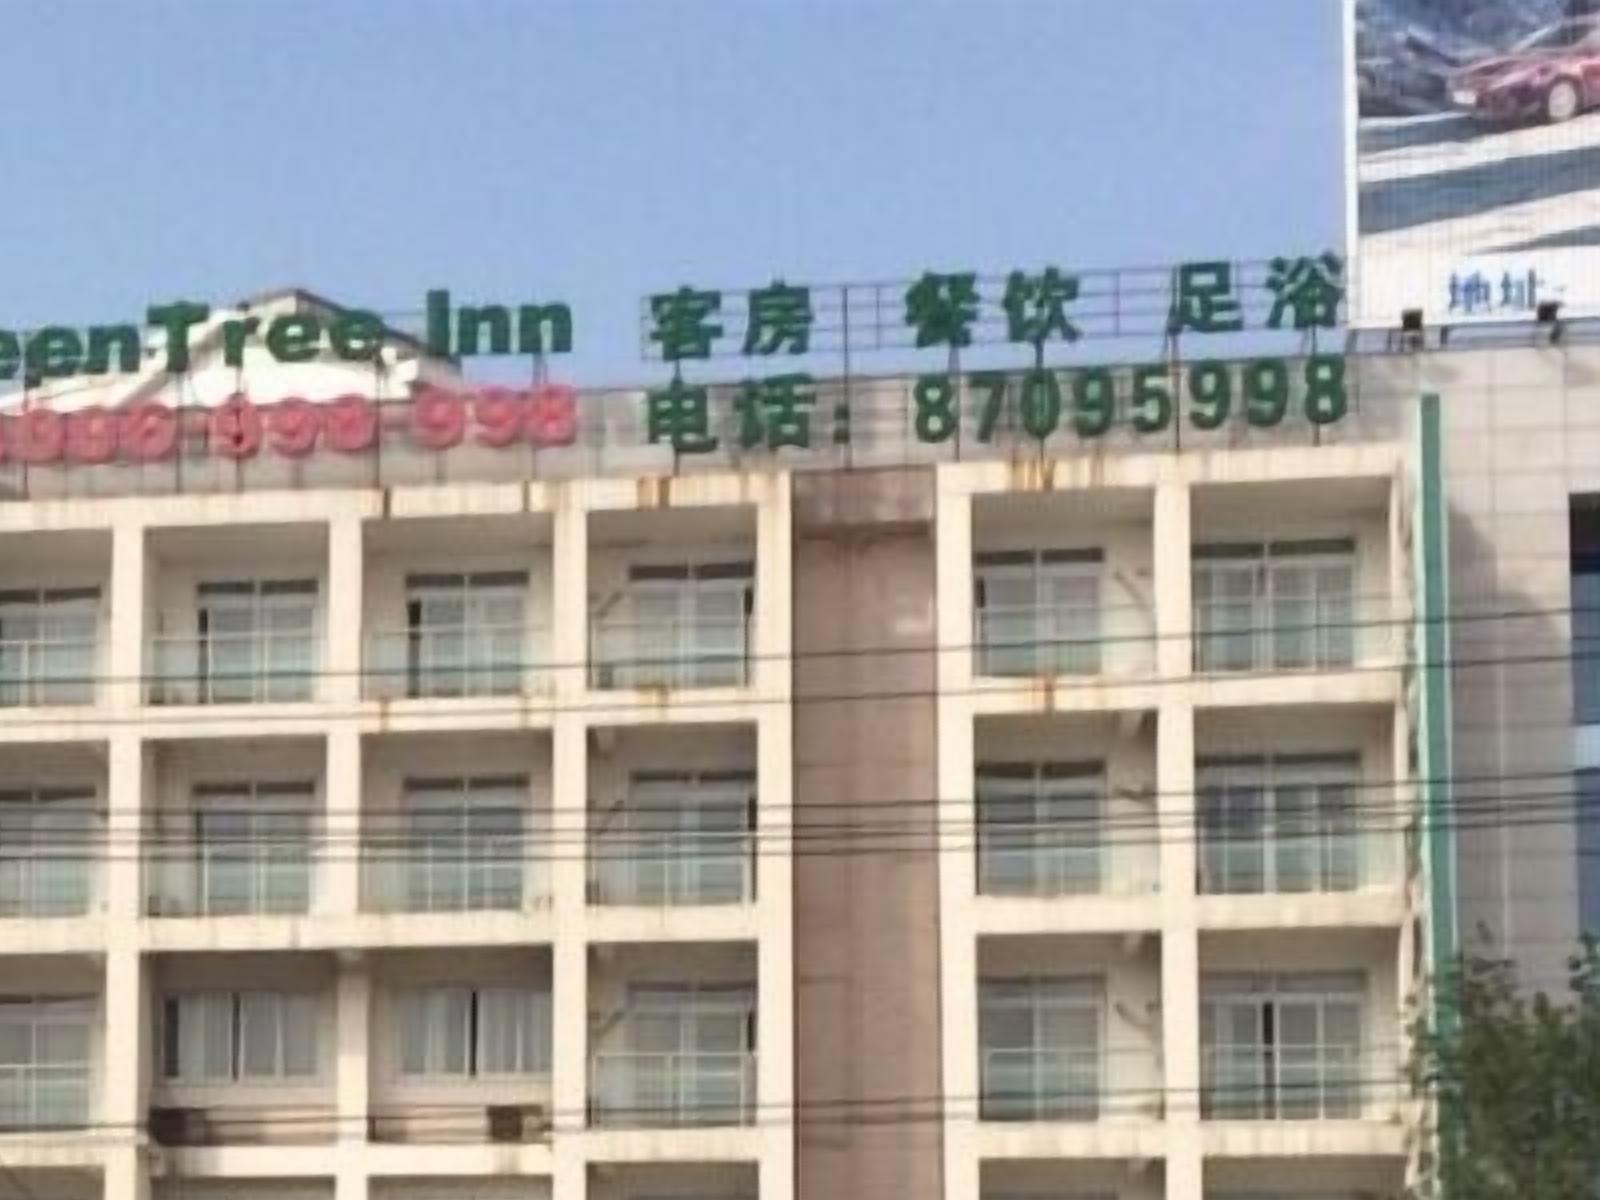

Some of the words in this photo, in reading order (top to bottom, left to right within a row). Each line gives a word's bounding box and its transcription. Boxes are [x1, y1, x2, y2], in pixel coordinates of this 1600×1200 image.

[425, 288, 574, 357] Inn
[649, 284, 815, 361] 客房
[905, 266, 1081, 348] 餐饮
[1170, 250, 1346, 334] 足浴
[912, 352, 1347, 445] 87095998
